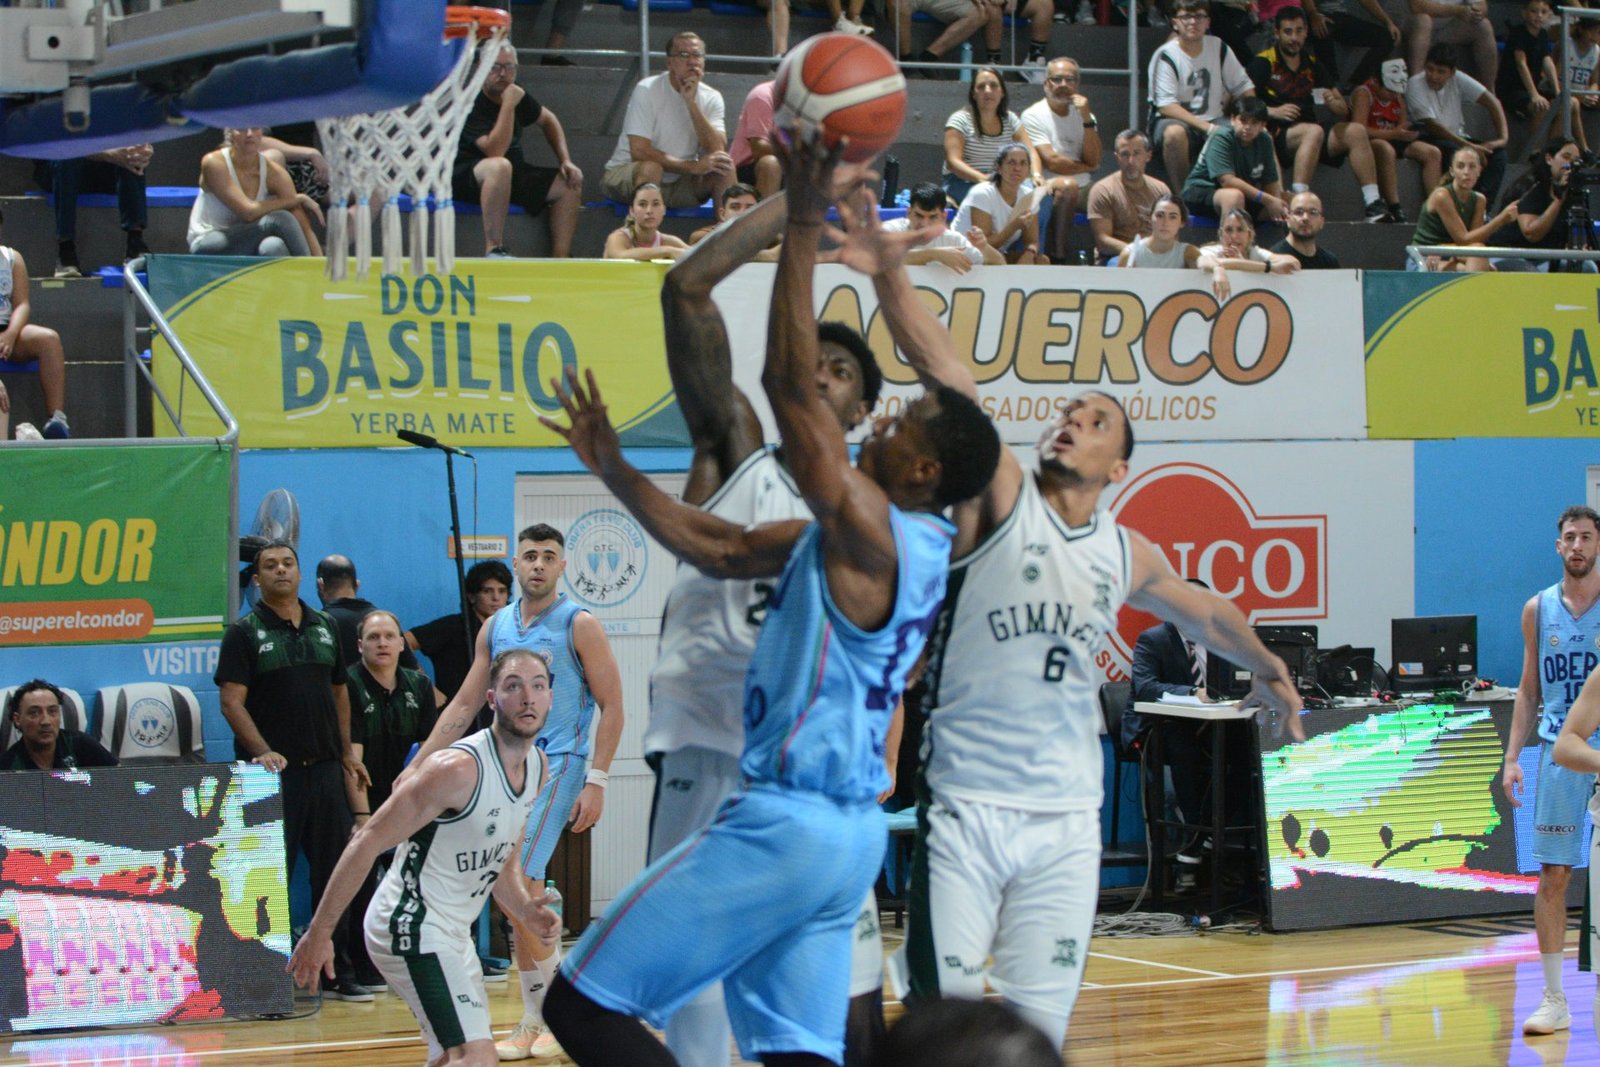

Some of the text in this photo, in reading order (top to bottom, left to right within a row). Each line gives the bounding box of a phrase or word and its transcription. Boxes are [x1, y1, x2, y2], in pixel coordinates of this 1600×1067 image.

[380, 273, 476, 316] DON
[278, 319, 578, 412] BASILIO
[351, 412, 516, 435] YERBA MATE
[0, 517, 157, 587] NDOR
[0, 609, 144, 634] @superelcondor
[1043, 645, 1071, 683] 6
